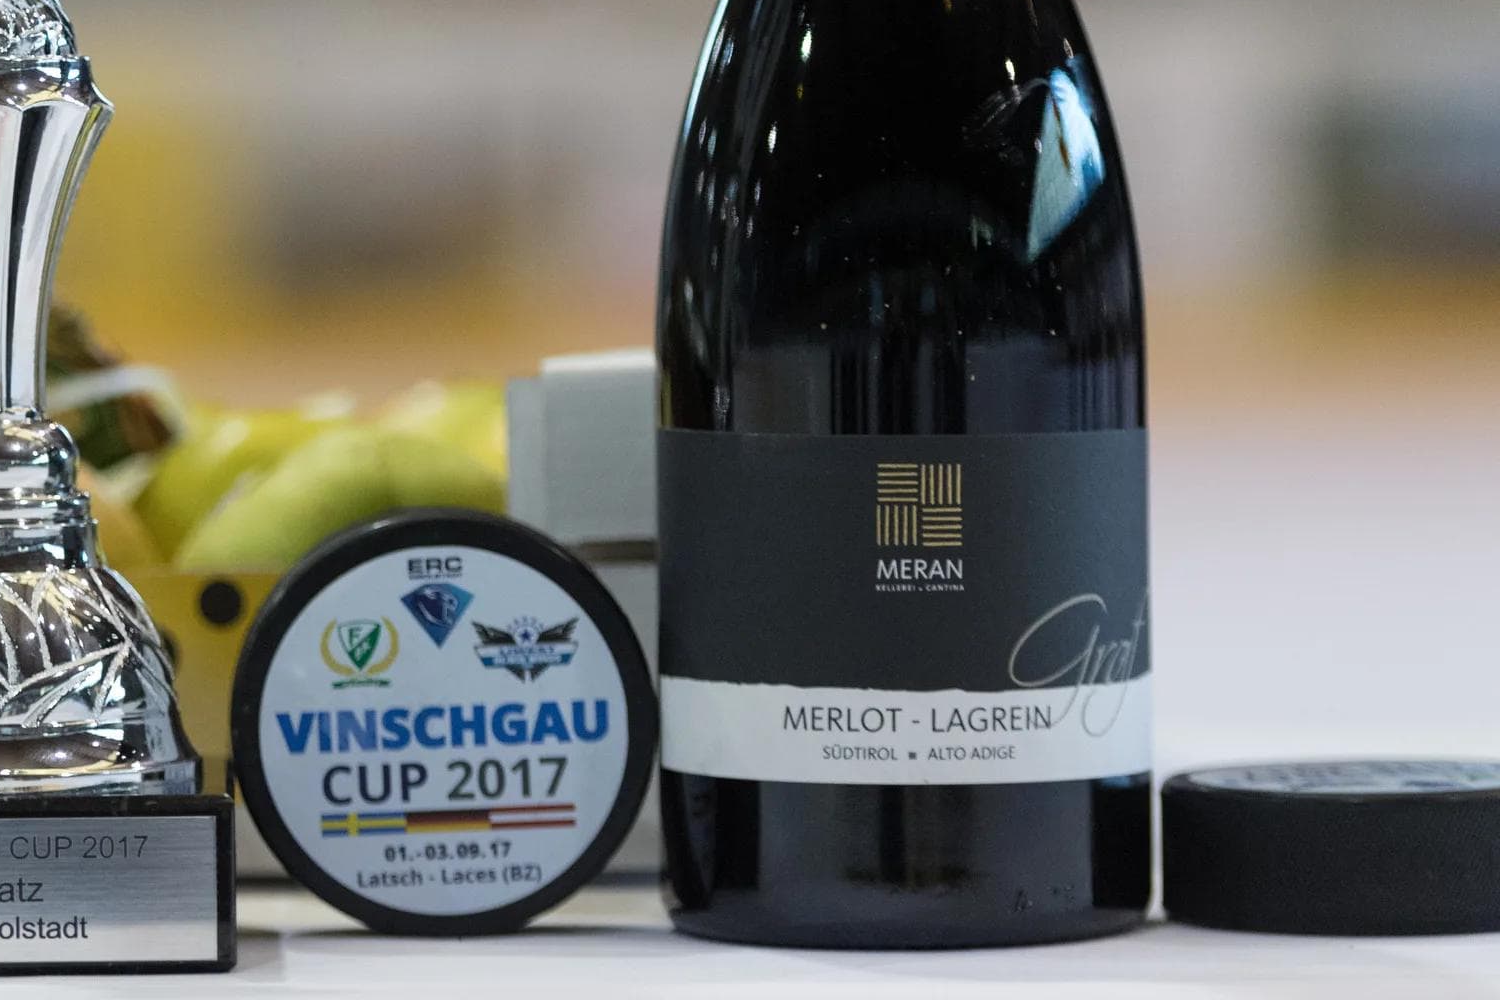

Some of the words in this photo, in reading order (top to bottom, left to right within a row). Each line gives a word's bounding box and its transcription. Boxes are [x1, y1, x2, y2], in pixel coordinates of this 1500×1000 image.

[408, 557, 462, 574] ERC
[876, 558, 964, 580] MERAN
[875, 583, 916, 592] KELLEREI
[925, 583, 965, 592] CANTINA
[276, 700, 608, 755] VINSCHGAU
[783, 706, 903, 733] MERLOT
[931, 705, 1052, 733] LAGREIN
[822, 744, 899, 761] SÜDTIROL
[928, 747, 966, 761] ALTO
[970, 746, 1016, 761] ADIGE
[322, 763, 427, 806] CUP
[446, 757, 568, 801] 2017
[10, 836, 73, 860] CUP
[82, 834, 148, 859] 2017
[357, 868, 423, 889] Latsch
[441, 868, 497, 886] Laces
[502, 864, 542, 885] (BZ)
